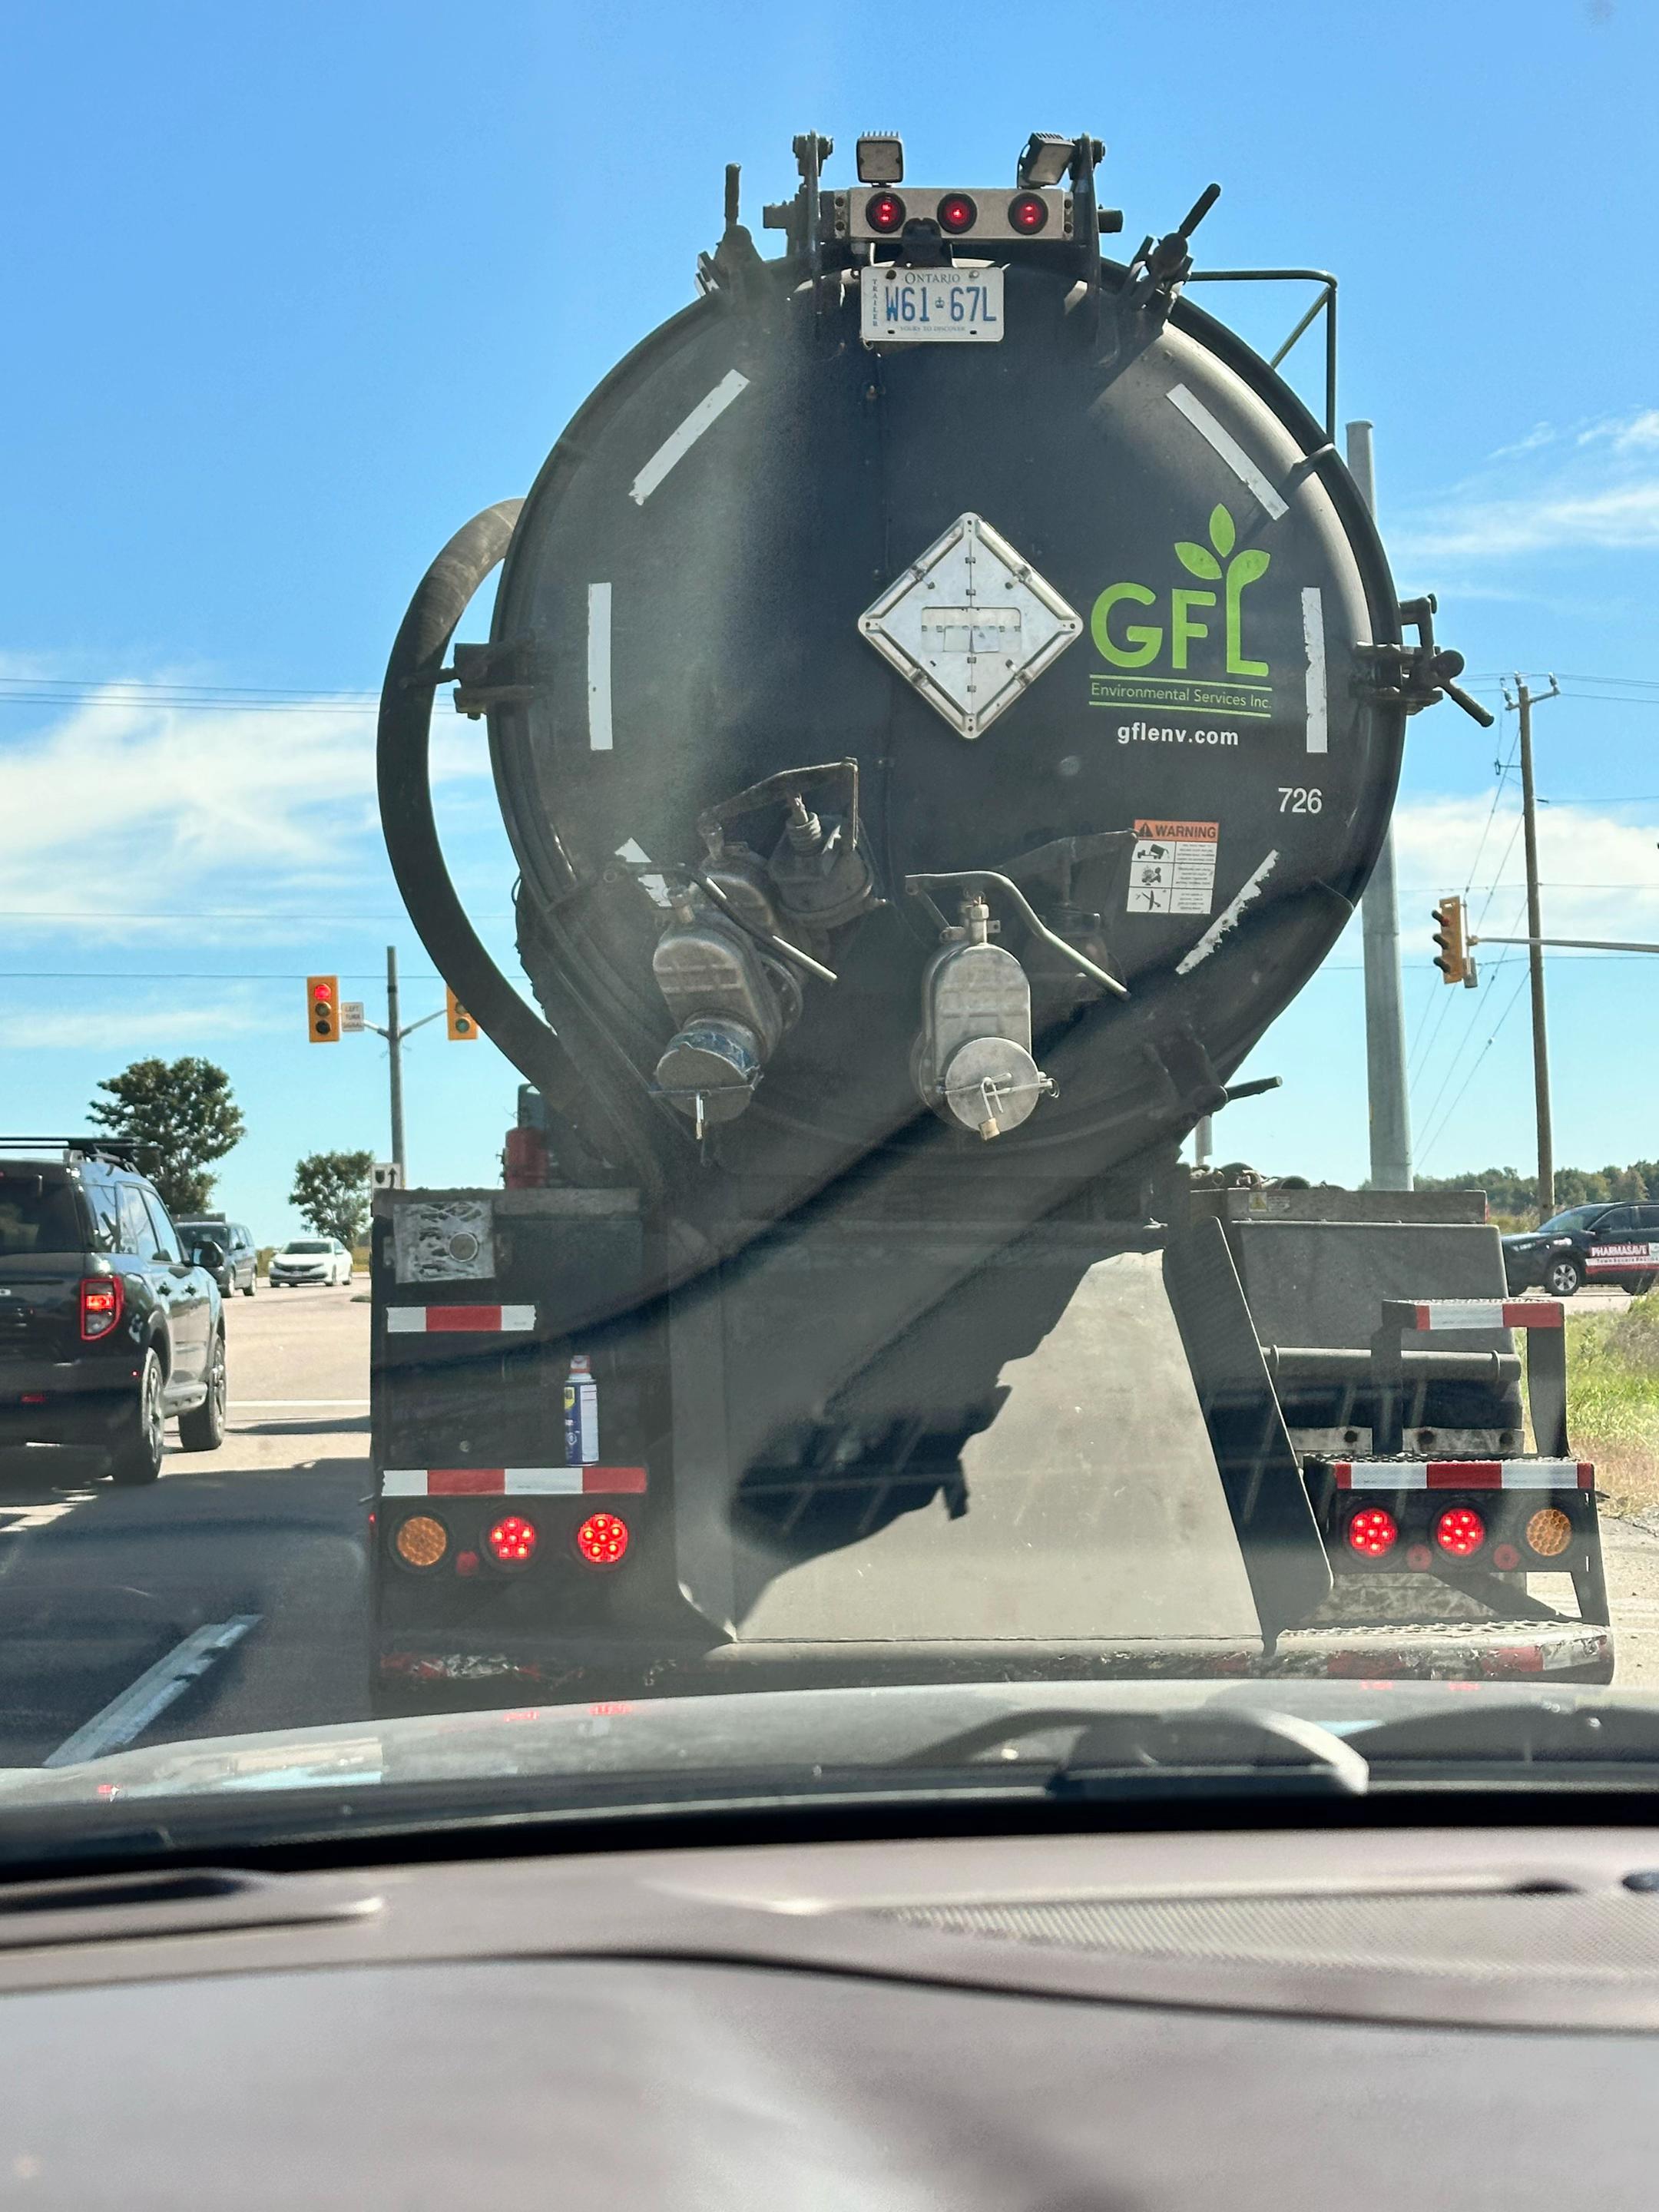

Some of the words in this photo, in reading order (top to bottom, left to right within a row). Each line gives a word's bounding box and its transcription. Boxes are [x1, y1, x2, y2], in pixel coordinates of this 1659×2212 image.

[886, 286, 930, 322] W61
[950, 286, 997, 322] 67L
[1091, 550, 1270, 677] GFL
[1091, 682, 1189, 701] Environmental
[1194, 690, 1246, 706] Services
[1250, 694, 1272, 708] Inc.
[1118, 722, 1238, 745] gflenv.com
[1278, 787, 1322, 814] 726
[1155, 825, 1216, 839] WARNING
[1591, 1245, 1647, 1257] PHARMASAVE
